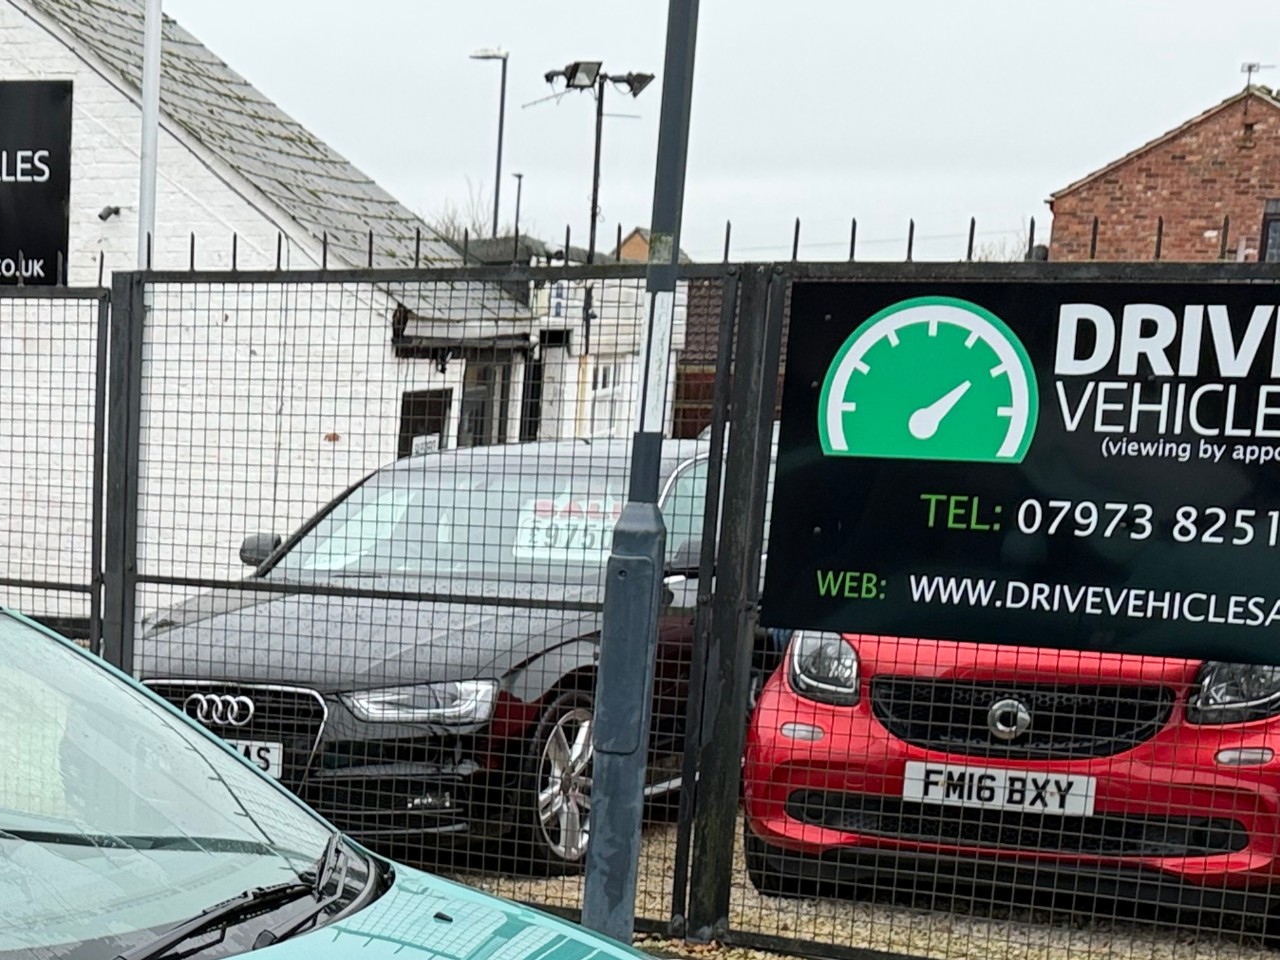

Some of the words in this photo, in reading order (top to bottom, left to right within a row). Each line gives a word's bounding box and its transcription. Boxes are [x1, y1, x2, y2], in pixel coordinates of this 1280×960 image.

[1054, 302, 1280, 379] DRIV
[1055, 380, 1280, 438] VEHICLE
[1101, 436, 1191, 461] (viewing
[1198, 438, 1227, 462] by
[920, 494, 1002, 531] TEL:
[1018, 499, 1153, 540] 07973
[1172, 505, 1280, 547] 8251
[816, 569, 886, 600] WEB:
[923, 769, 996, 803] FM16
[1006, 775, 1074, 809] BXY
